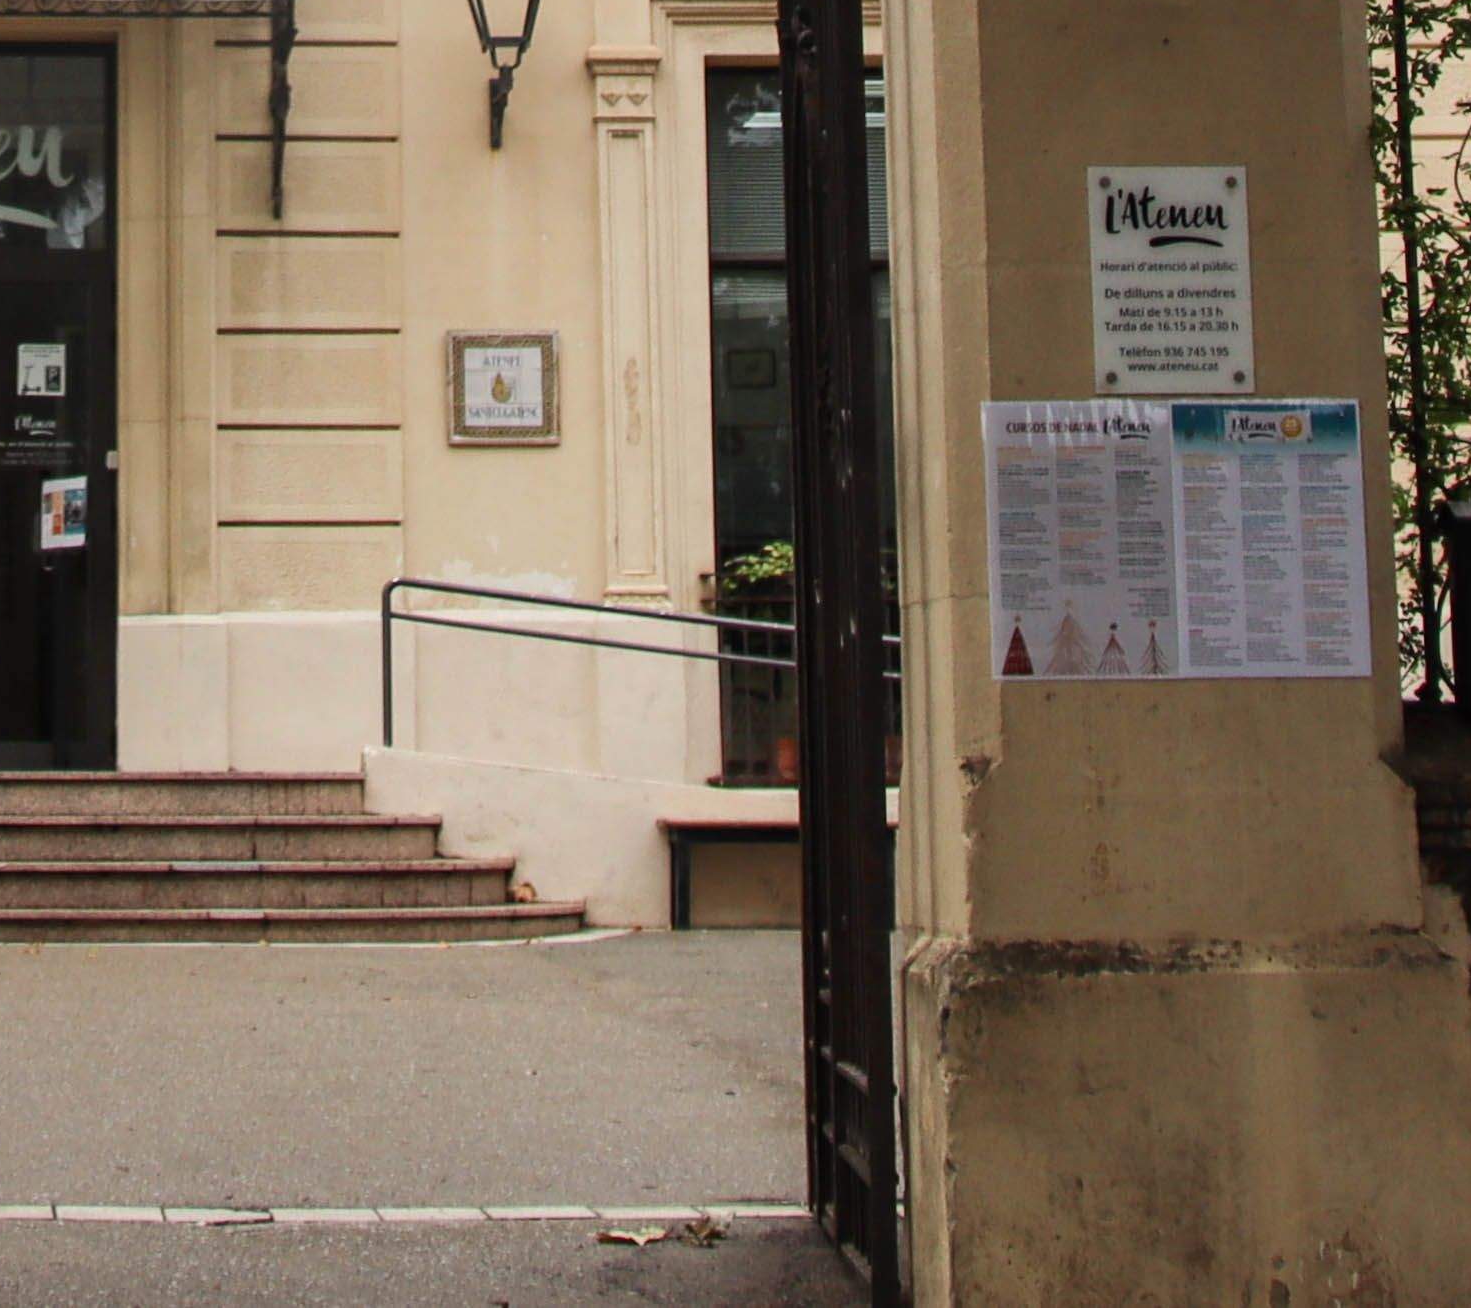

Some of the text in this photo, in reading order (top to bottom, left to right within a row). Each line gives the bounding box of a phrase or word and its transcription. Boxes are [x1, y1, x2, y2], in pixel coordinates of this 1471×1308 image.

[1105, 185, 1229, 234] L'Ateneu
[1100, 262, 1135, 272] Horari
[1137, 261, 1187, 272] d'atenció
[1190, 262, 1201, 272] al
[1104, 288, 1237, 299] De dilluns a divendres
[1119, 307, 1145, 318] Matí
[1147, 307, 1161, 318] de
[1163, 307, 1188, 318] 9.15
[1201, 307, 1213, 318] 13
[1215, 306, 1224, 317] h
[1104, 321, 1137, 332] Tarda
[1139, 321, 1154, 331] de
[1158, 321, 1187, 332] 16.15
[1199, 321, 1229, 331] 20.30
[1231, 321, 1239, 331] h
[1119, 346, 1230, 357] Telèfon 936 745 195
[1127, 362, 1220, 372] www.ateneu.cat
[1006, 421, 1047, 434] CURSOS
